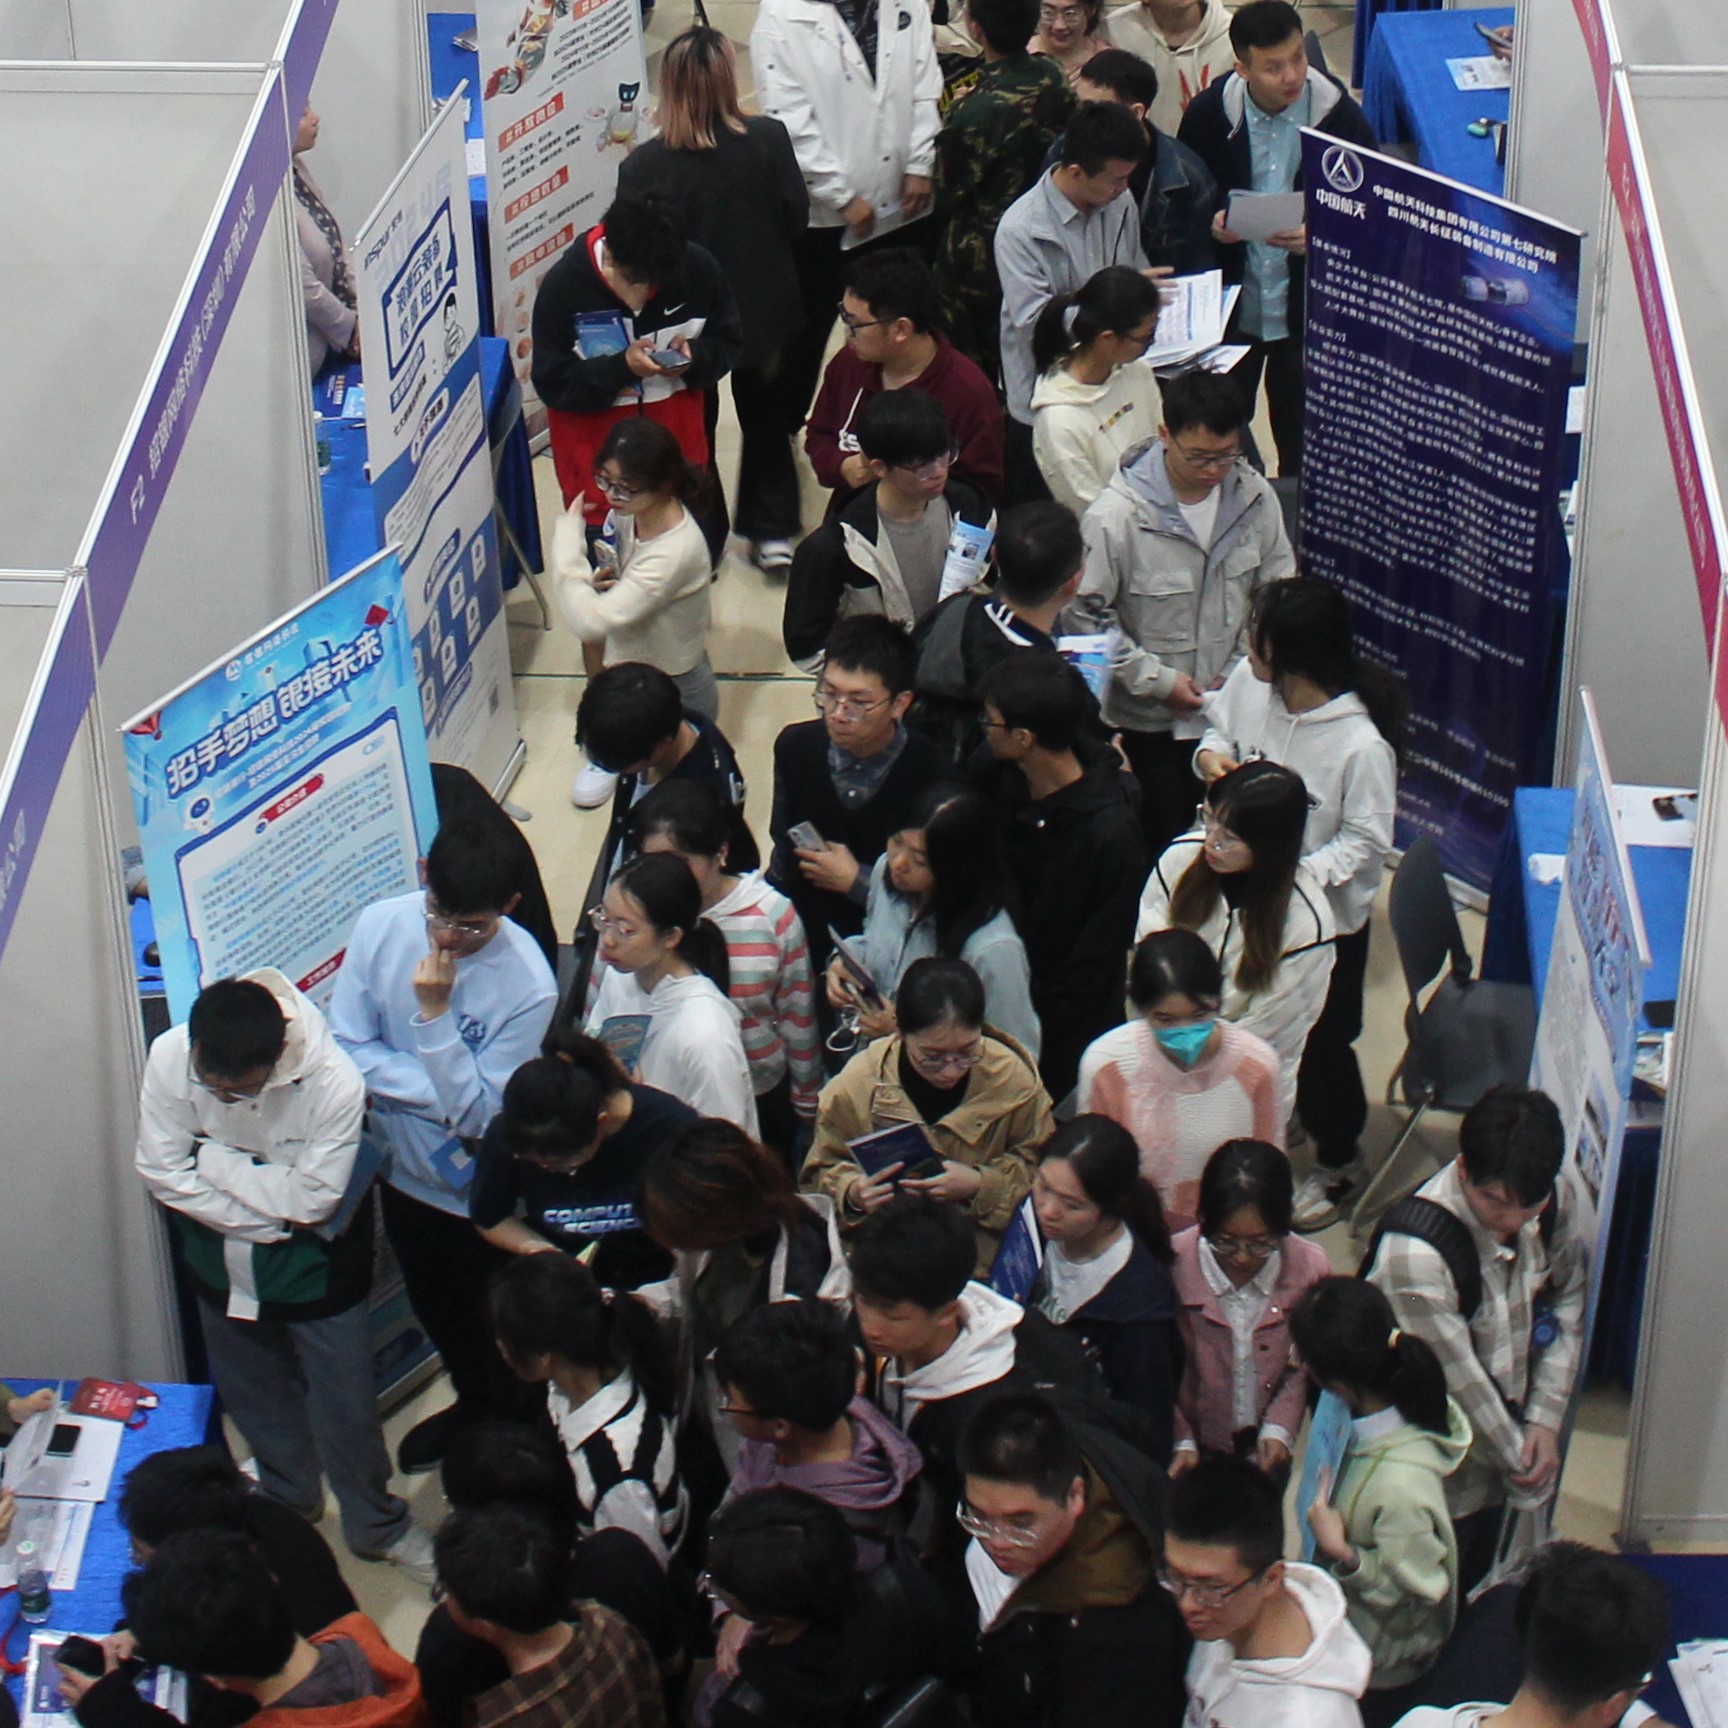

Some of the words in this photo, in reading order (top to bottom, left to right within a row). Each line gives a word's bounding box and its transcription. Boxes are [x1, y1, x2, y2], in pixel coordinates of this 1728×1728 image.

[1316, 188, 1367, 220] 中国航天
[129, 474, 145, 526] F2
[166, 704, 278, 796] 招手梦想
[278, 629, 384, 722] 银接未来
